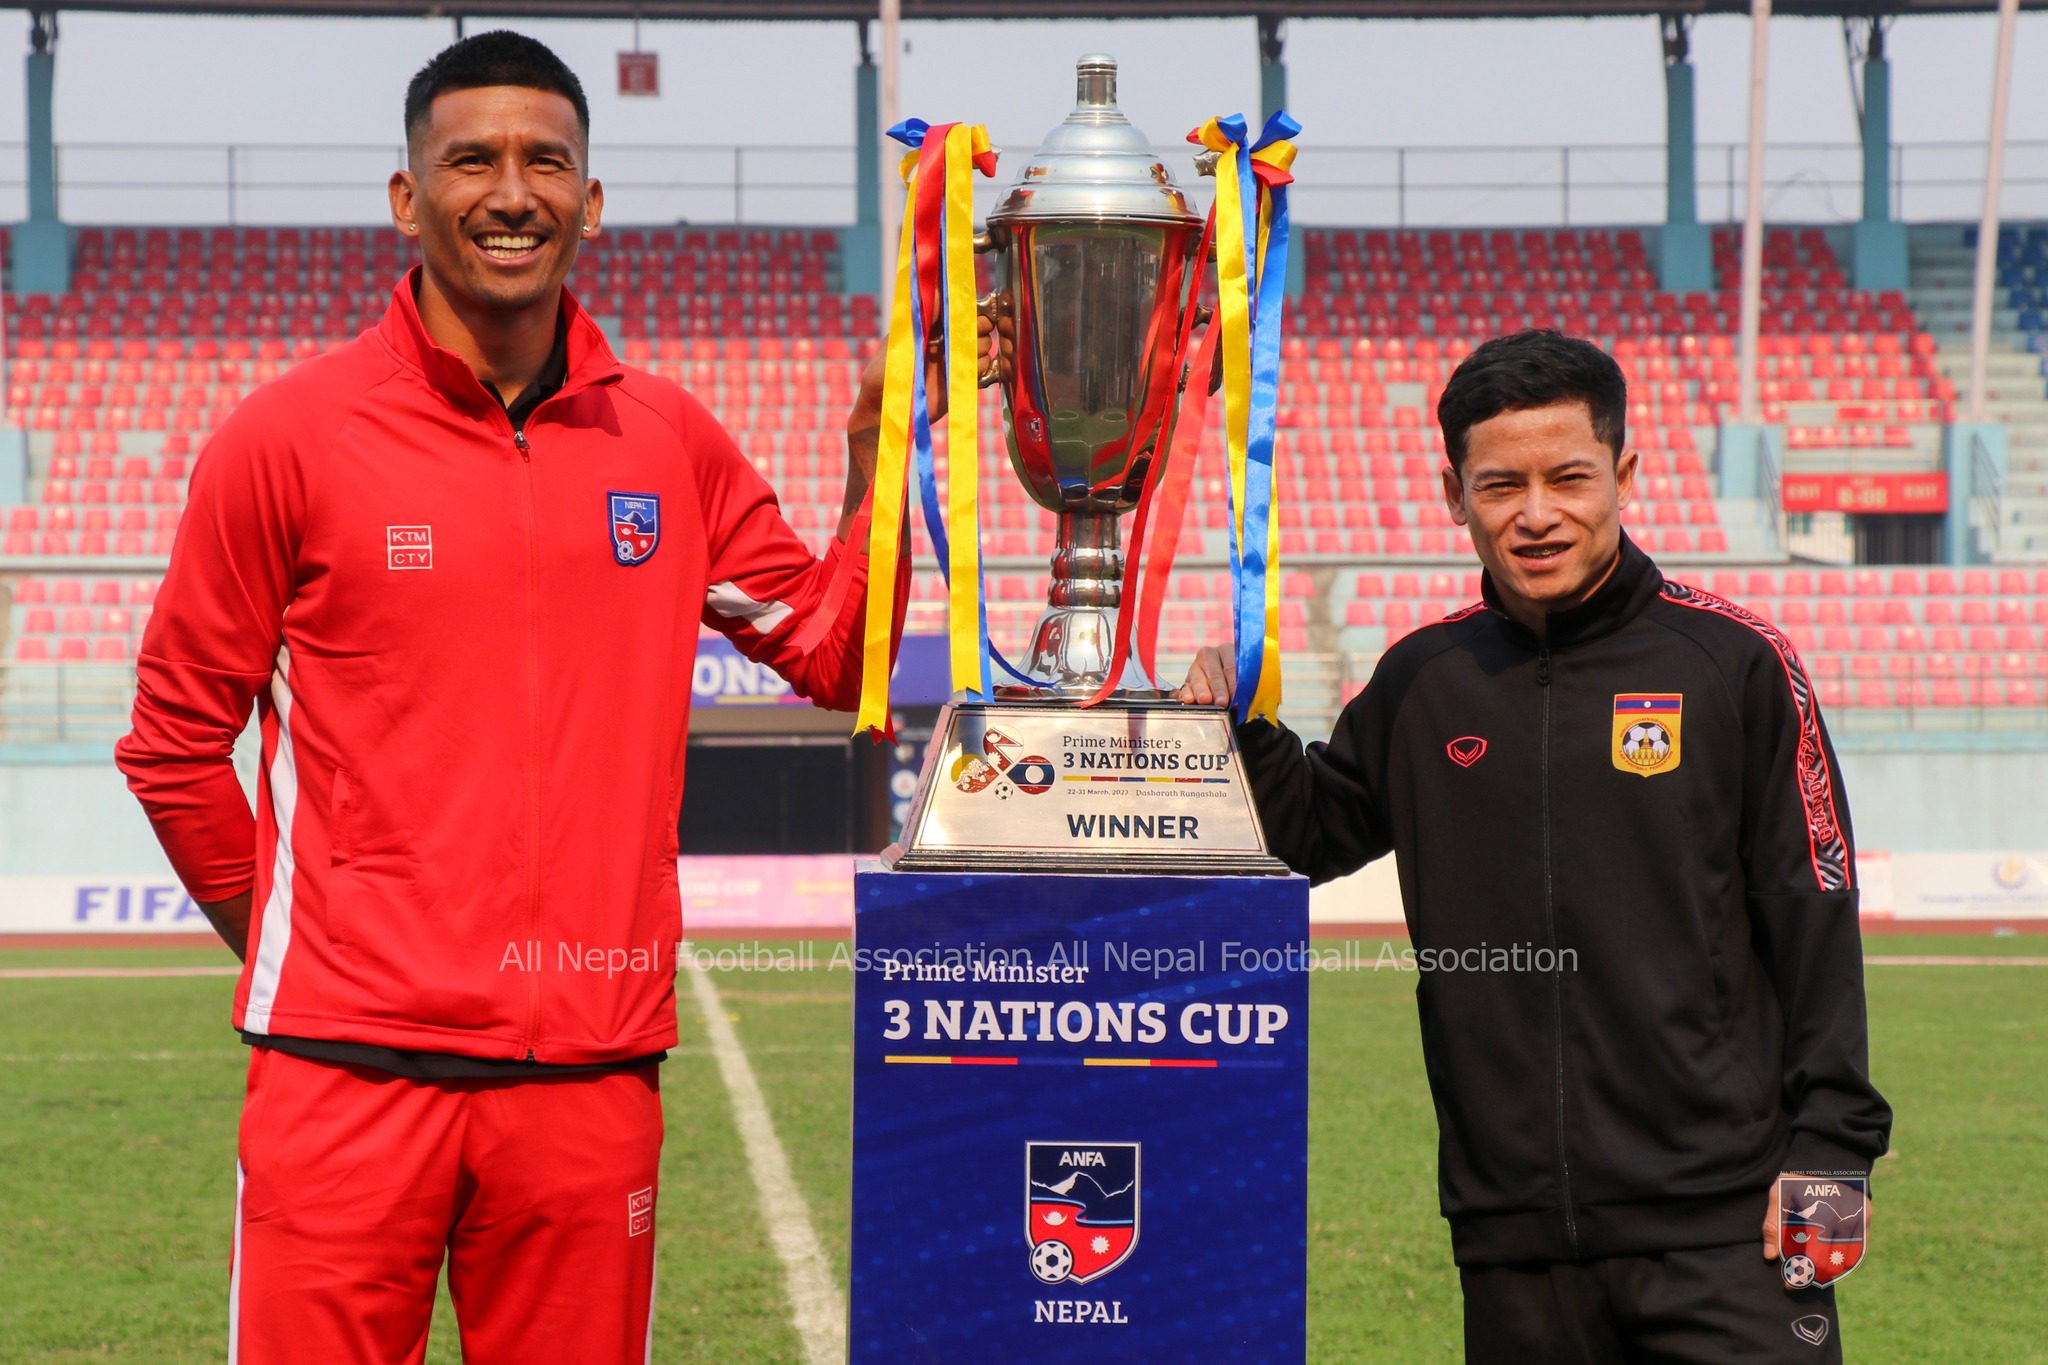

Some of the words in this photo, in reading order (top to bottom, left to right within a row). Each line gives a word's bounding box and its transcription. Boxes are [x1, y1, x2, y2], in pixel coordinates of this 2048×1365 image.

[625, 501, 647, 510] NEPAL
[392, 531, 427, 543] KTM
[394, 553, 427, 564] CTY
[1063, 736, 1106, 748] Prime
[1109, 736, 1182, 749] Minister's
[1063, 752, 1074, 768] 3
[1080, 753, 1180, 770] NATIONS
[1185, 754, 1230, 771] CUP
[1067, 814, 1200, 840] WINNER
[883, 959, 966, 983] Prime
[972, 959, 1089, 984] Minister
[883, 999, 911, 1040] 3
[923, 1000, 1167, 1043] NATIONS
[1180, 1003, 1289, 1045] CUP
[1059, 1151, 1106, 1167] ANFA
[1034, 1300, 1128, 1324] NEPAL
